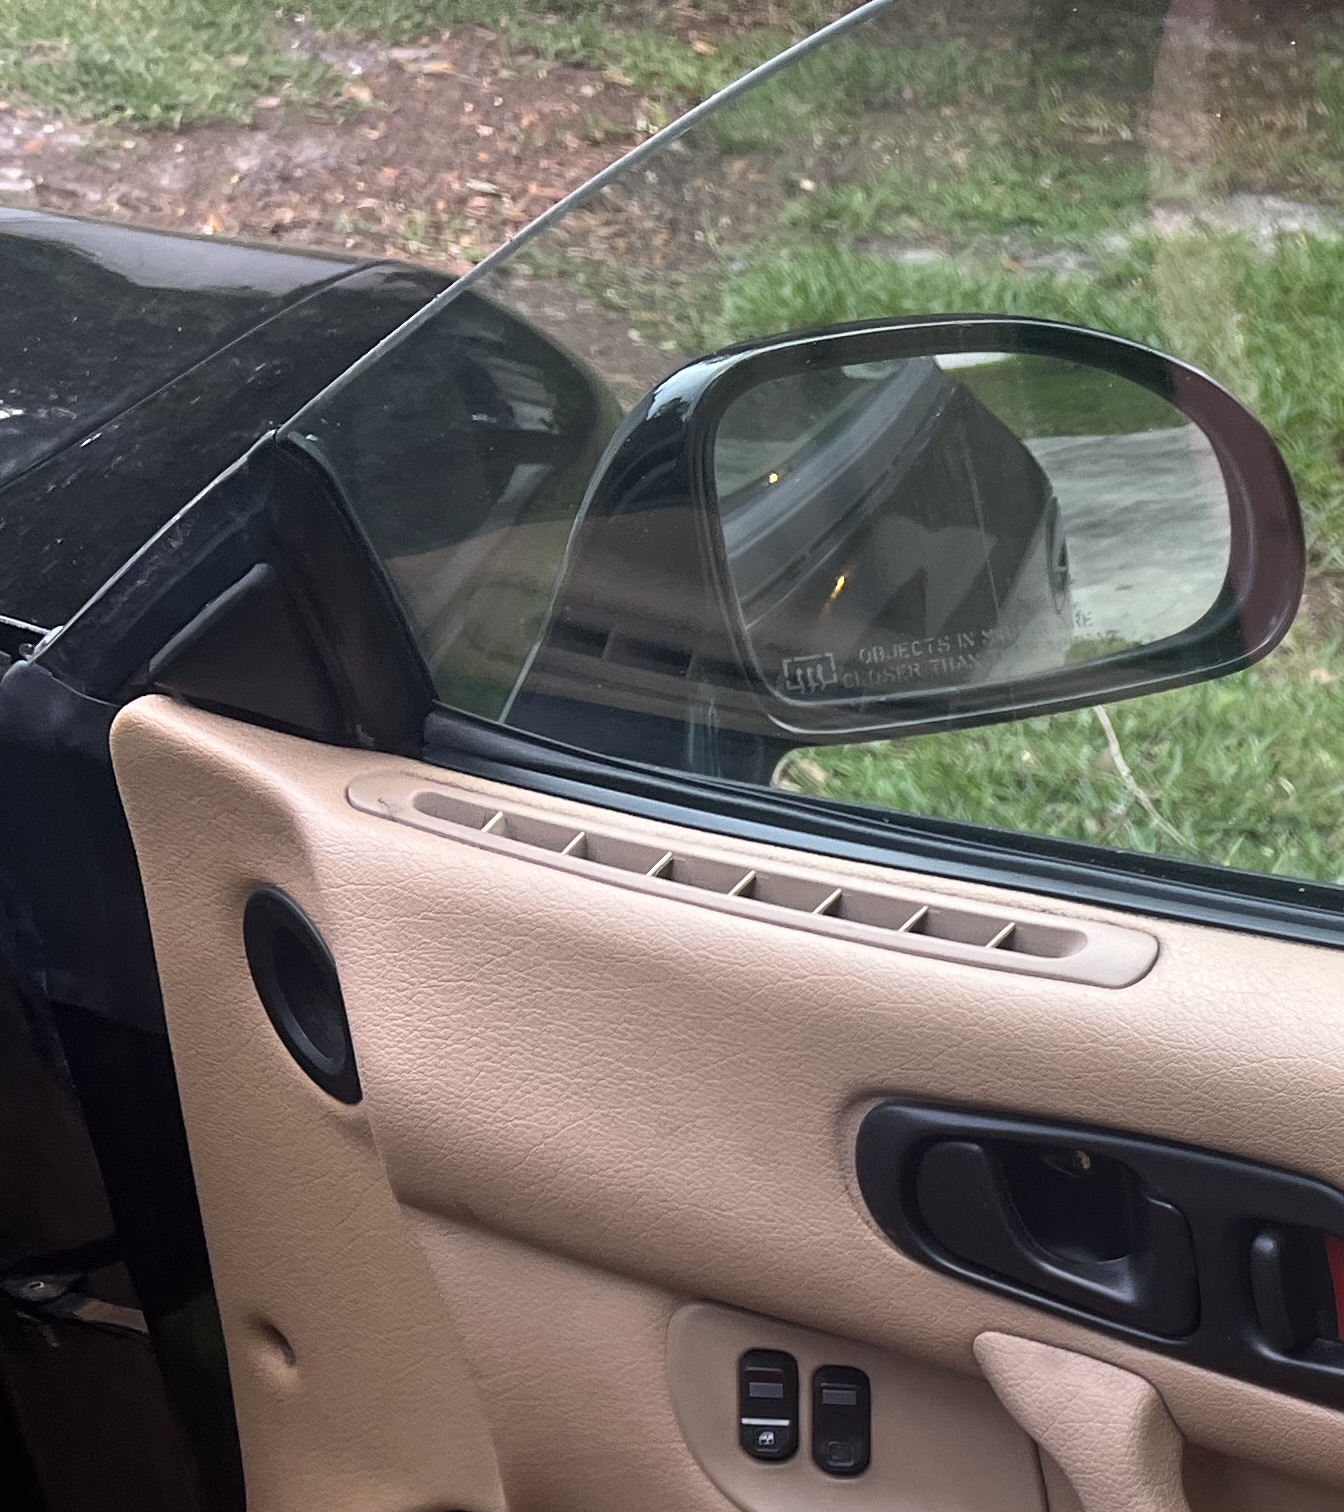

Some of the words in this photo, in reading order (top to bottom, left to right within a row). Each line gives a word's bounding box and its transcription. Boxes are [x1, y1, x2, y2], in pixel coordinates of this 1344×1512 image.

[860, 636, 950, 664] OBJECTS
[957, 631, 976, 648] IN
[841, 662, 921, 688] CLOSER
